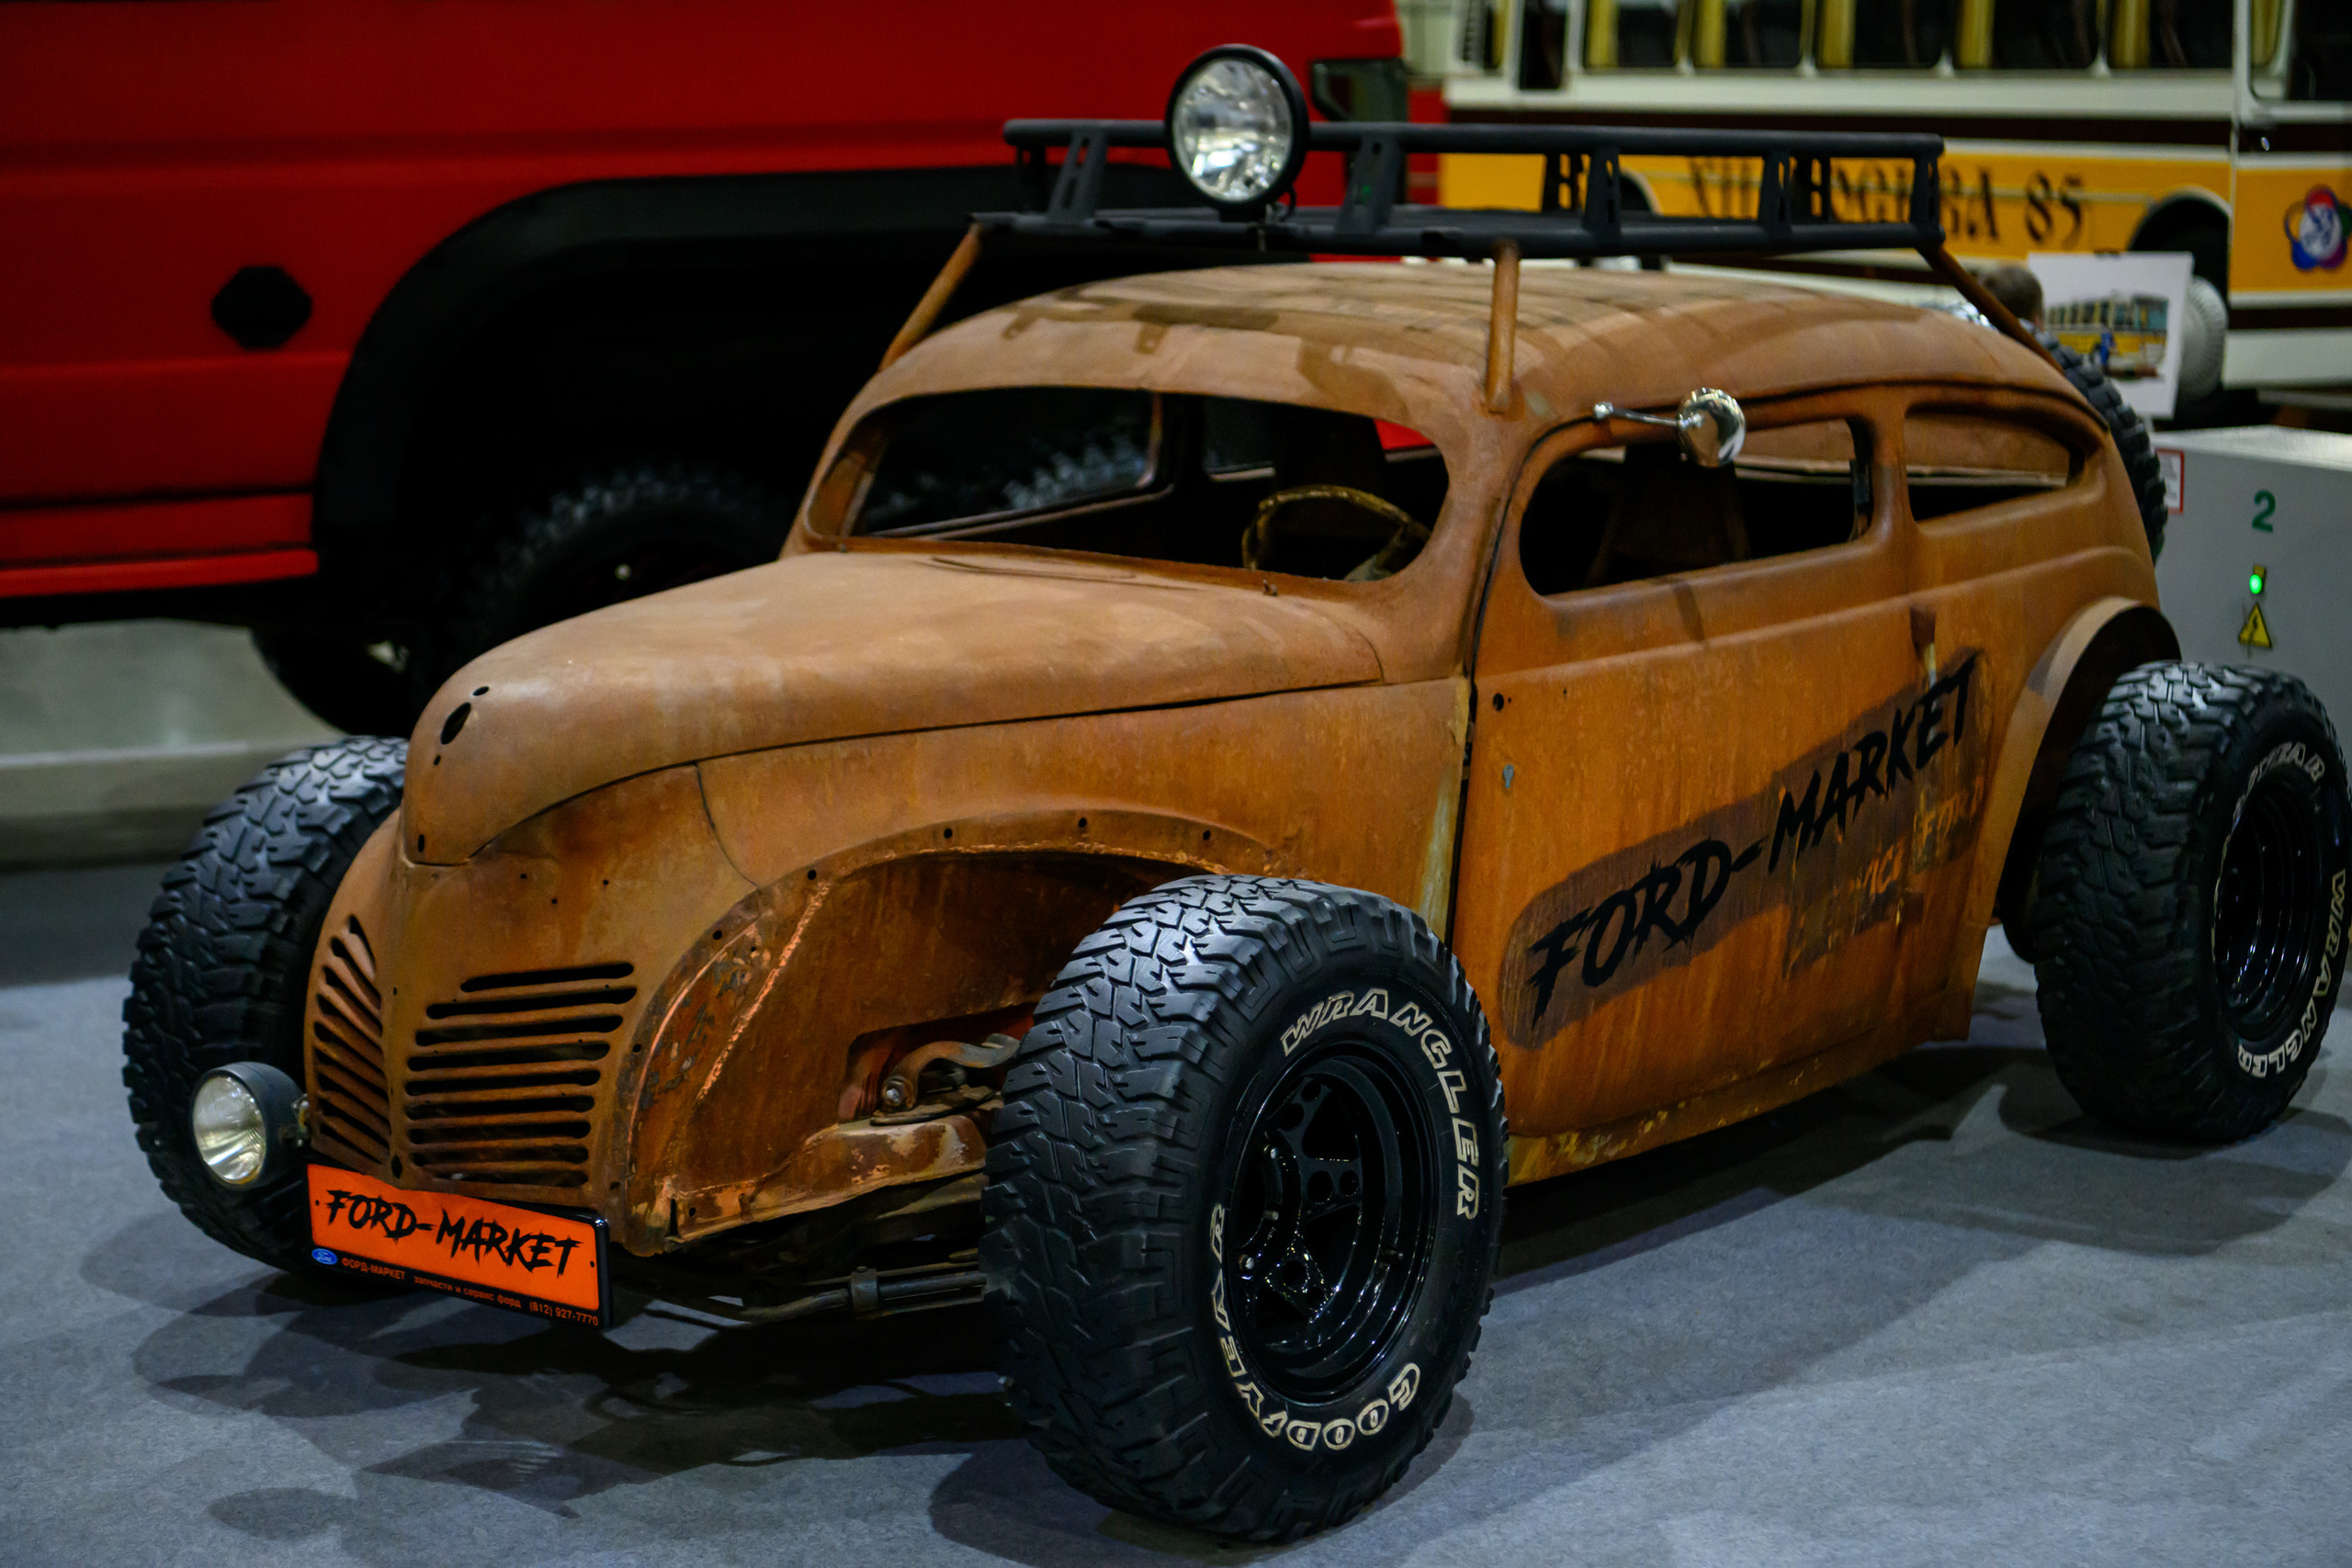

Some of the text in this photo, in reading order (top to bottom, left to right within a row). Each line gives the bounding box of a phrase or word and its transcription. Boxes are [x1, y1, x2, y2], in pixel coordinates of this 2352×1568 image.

[2024, 169, 2084, 246] 85
[2252, 490, 2276, 532] 2
[1528, 651, 1977, 1030] FORD-MARKET
[2237, 867, 2346, 1079] WRANGLER
[1281, 987, 1479, 1220] WRANGLER
[325, 1190, 582, 1279] FORD-MARKET
[341, 1257, 406, 1280] ФОРД-МАРКЕТ
[463, 1288, 494, 1300] сервис
[496, 1293, 522, 1309] форд
[529, 1301, 553, 1317] (812)
[555, 1306, 599, 1326] 927-7770
[1210, 1202, 1420, 1452] GOODYEAR
